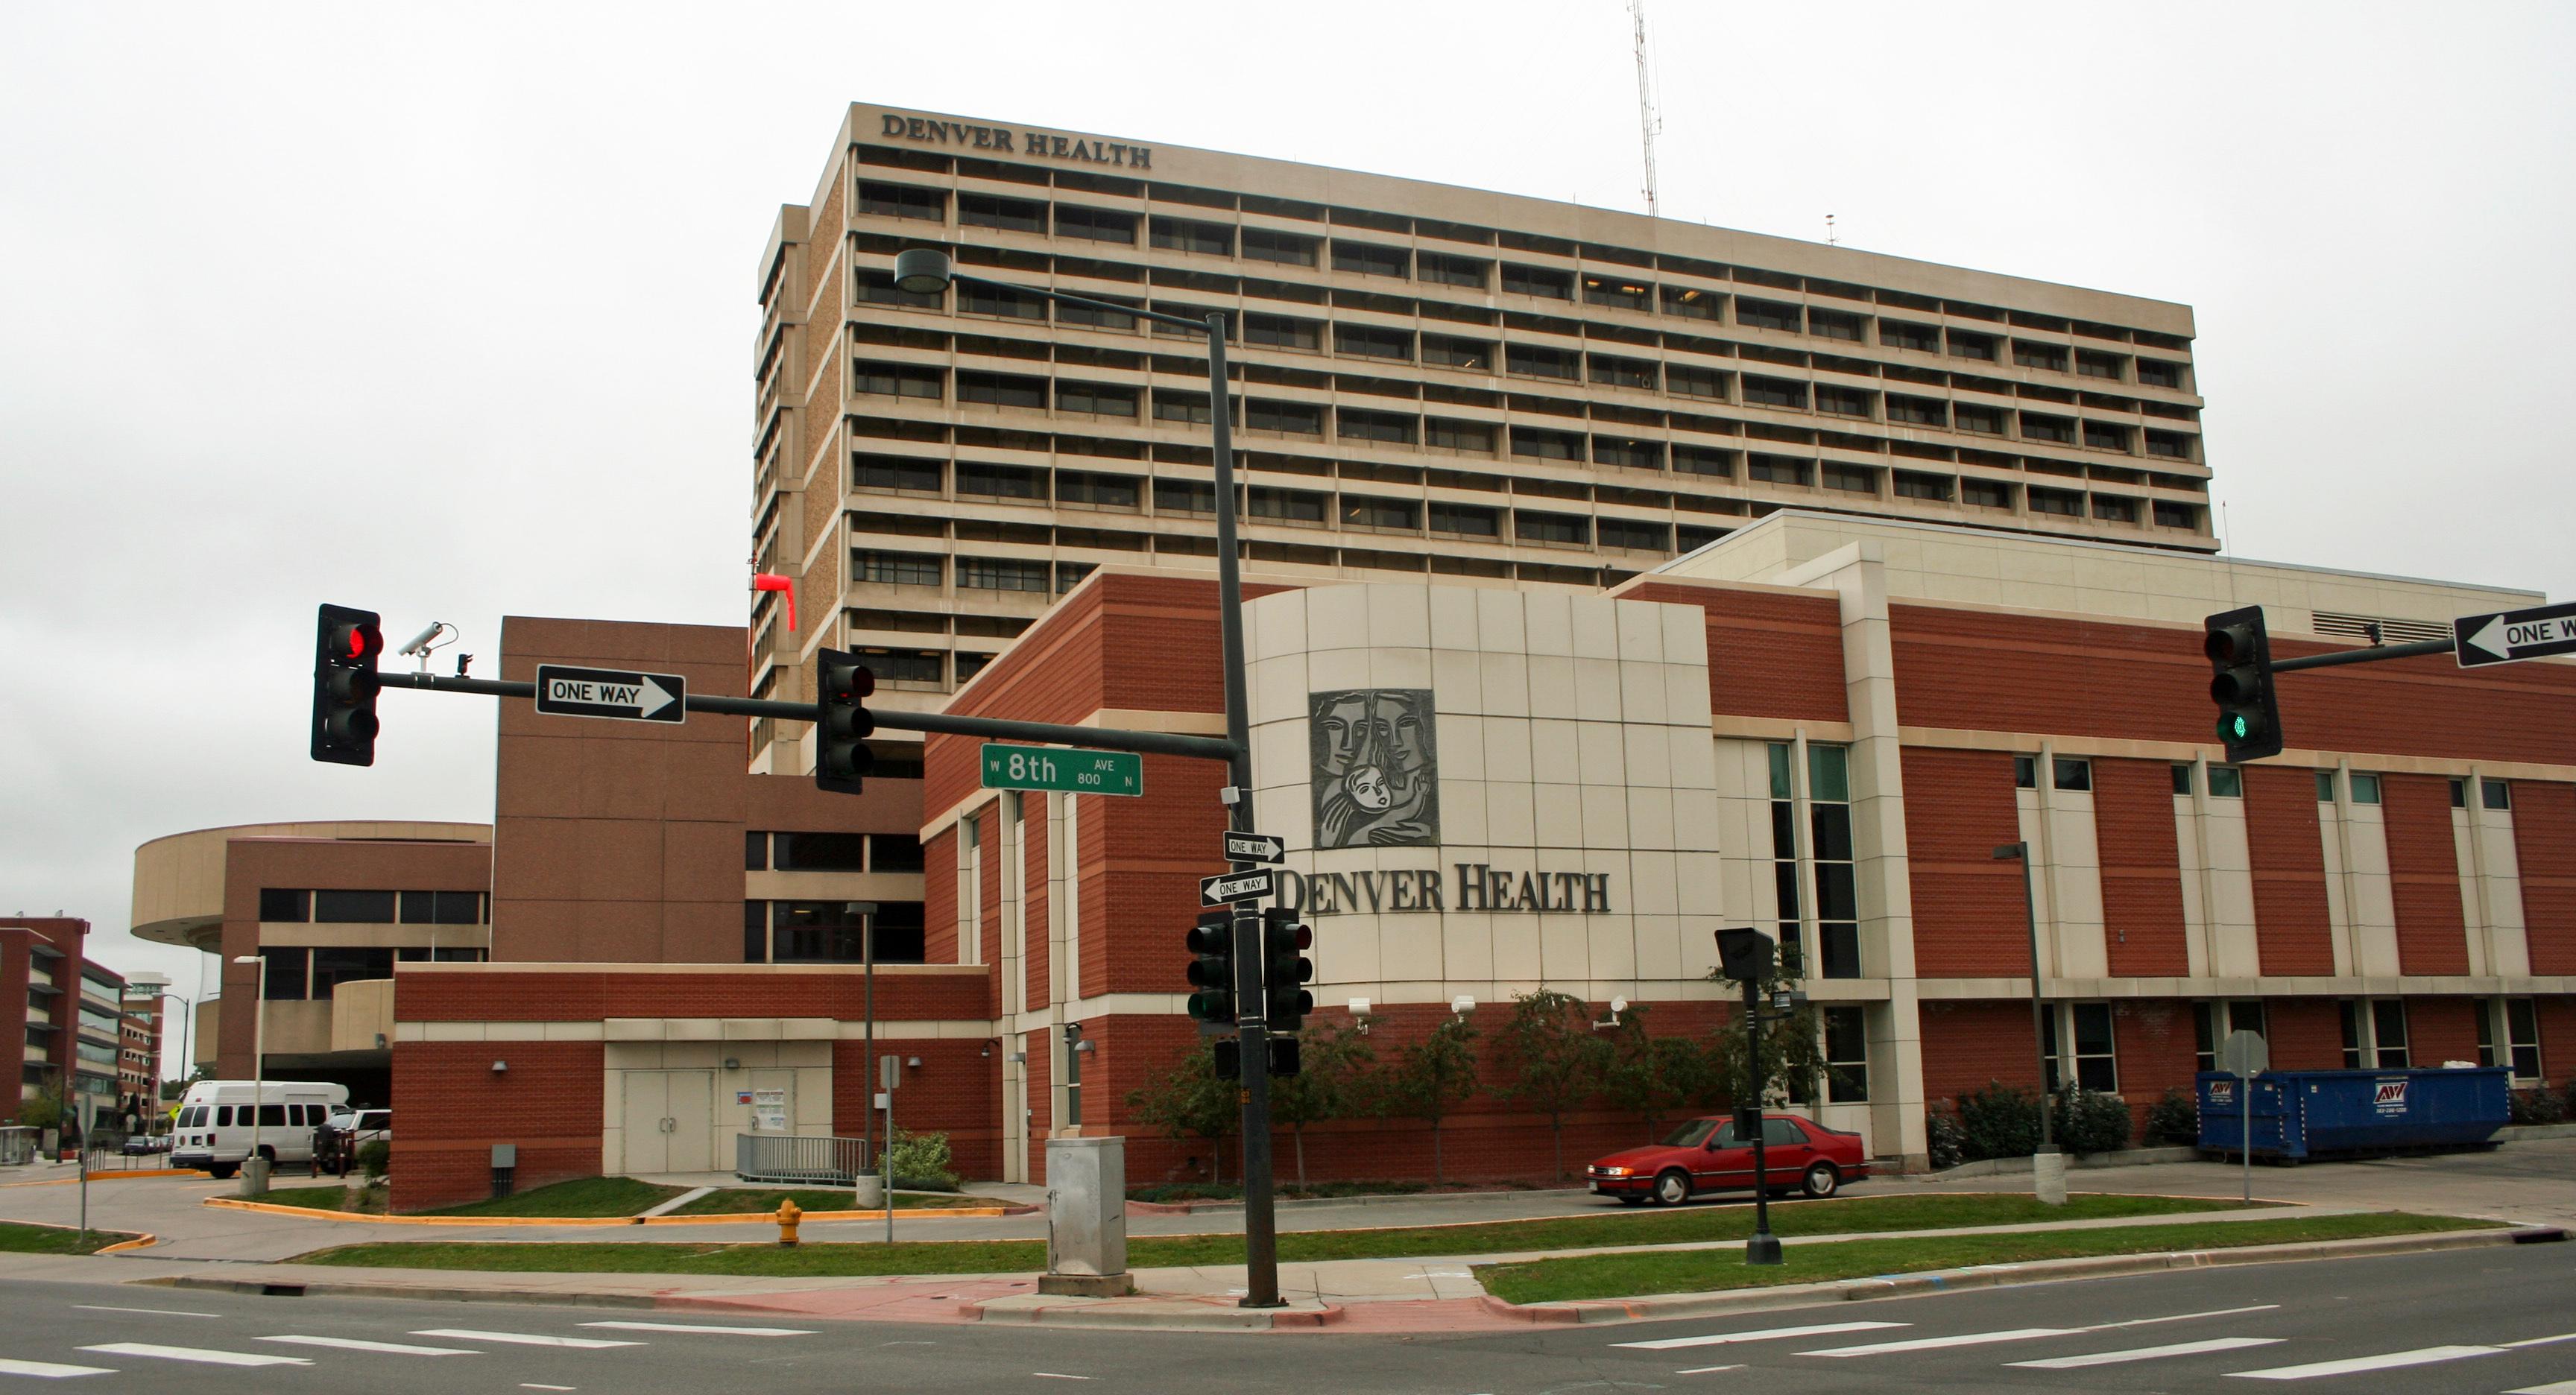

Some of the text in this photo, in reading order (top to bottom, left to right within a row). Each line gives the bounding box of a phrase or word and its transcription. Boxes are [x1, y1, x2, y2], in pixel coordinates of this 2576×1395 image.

[882, 114, 1152, 169] DENVER HEALTH
[2507, 623, 2554, 645] ONE
[553, 681, 640, 704] ONE WAY
[990, 753, 1114, 782] W 8th AVE
[1078, 773, 1132, 787] 800 N
[1231, 841, 1267, 854] ONE WAY
[1219, 878, 1263, 894] ONE WAY
[1273, 863, 1611, 914] DENVER HEALTH
